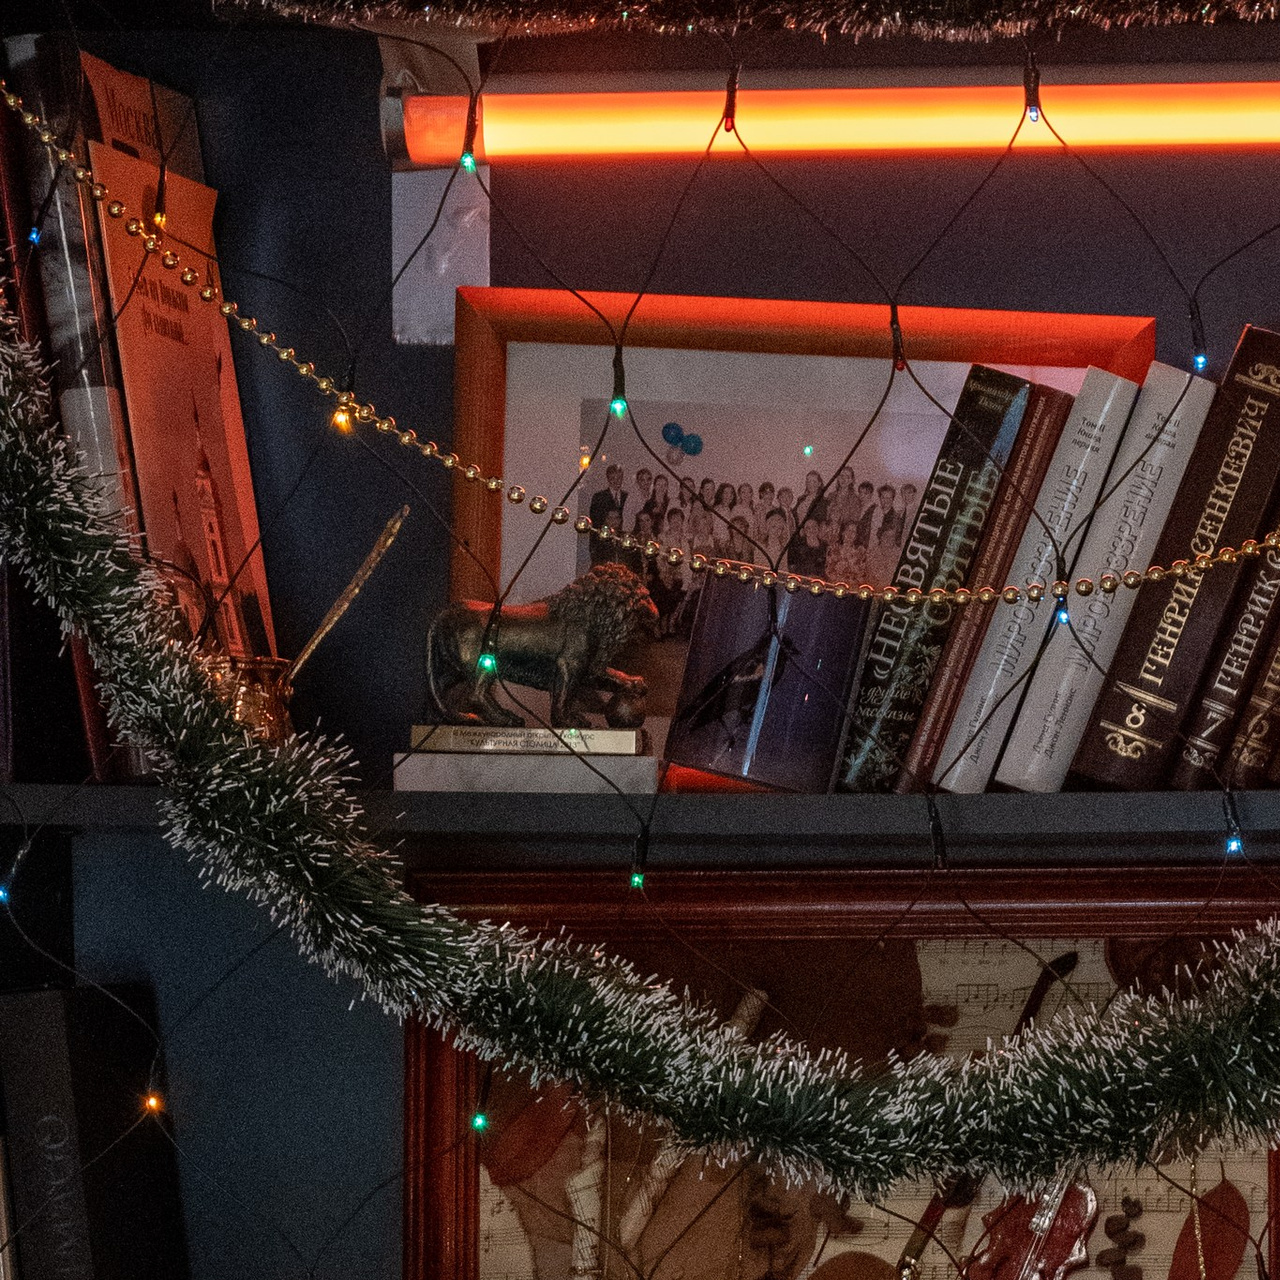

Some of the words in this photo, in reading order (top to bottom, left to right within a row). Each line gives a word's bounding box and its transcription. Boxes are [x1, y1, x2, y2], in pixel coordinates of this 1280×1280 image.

[1180, 393, 1279, 561] СЕНКЕВИЧ
[1125, 700, 1147, 729] 8
[1200, 710, 1223, 740] 7
